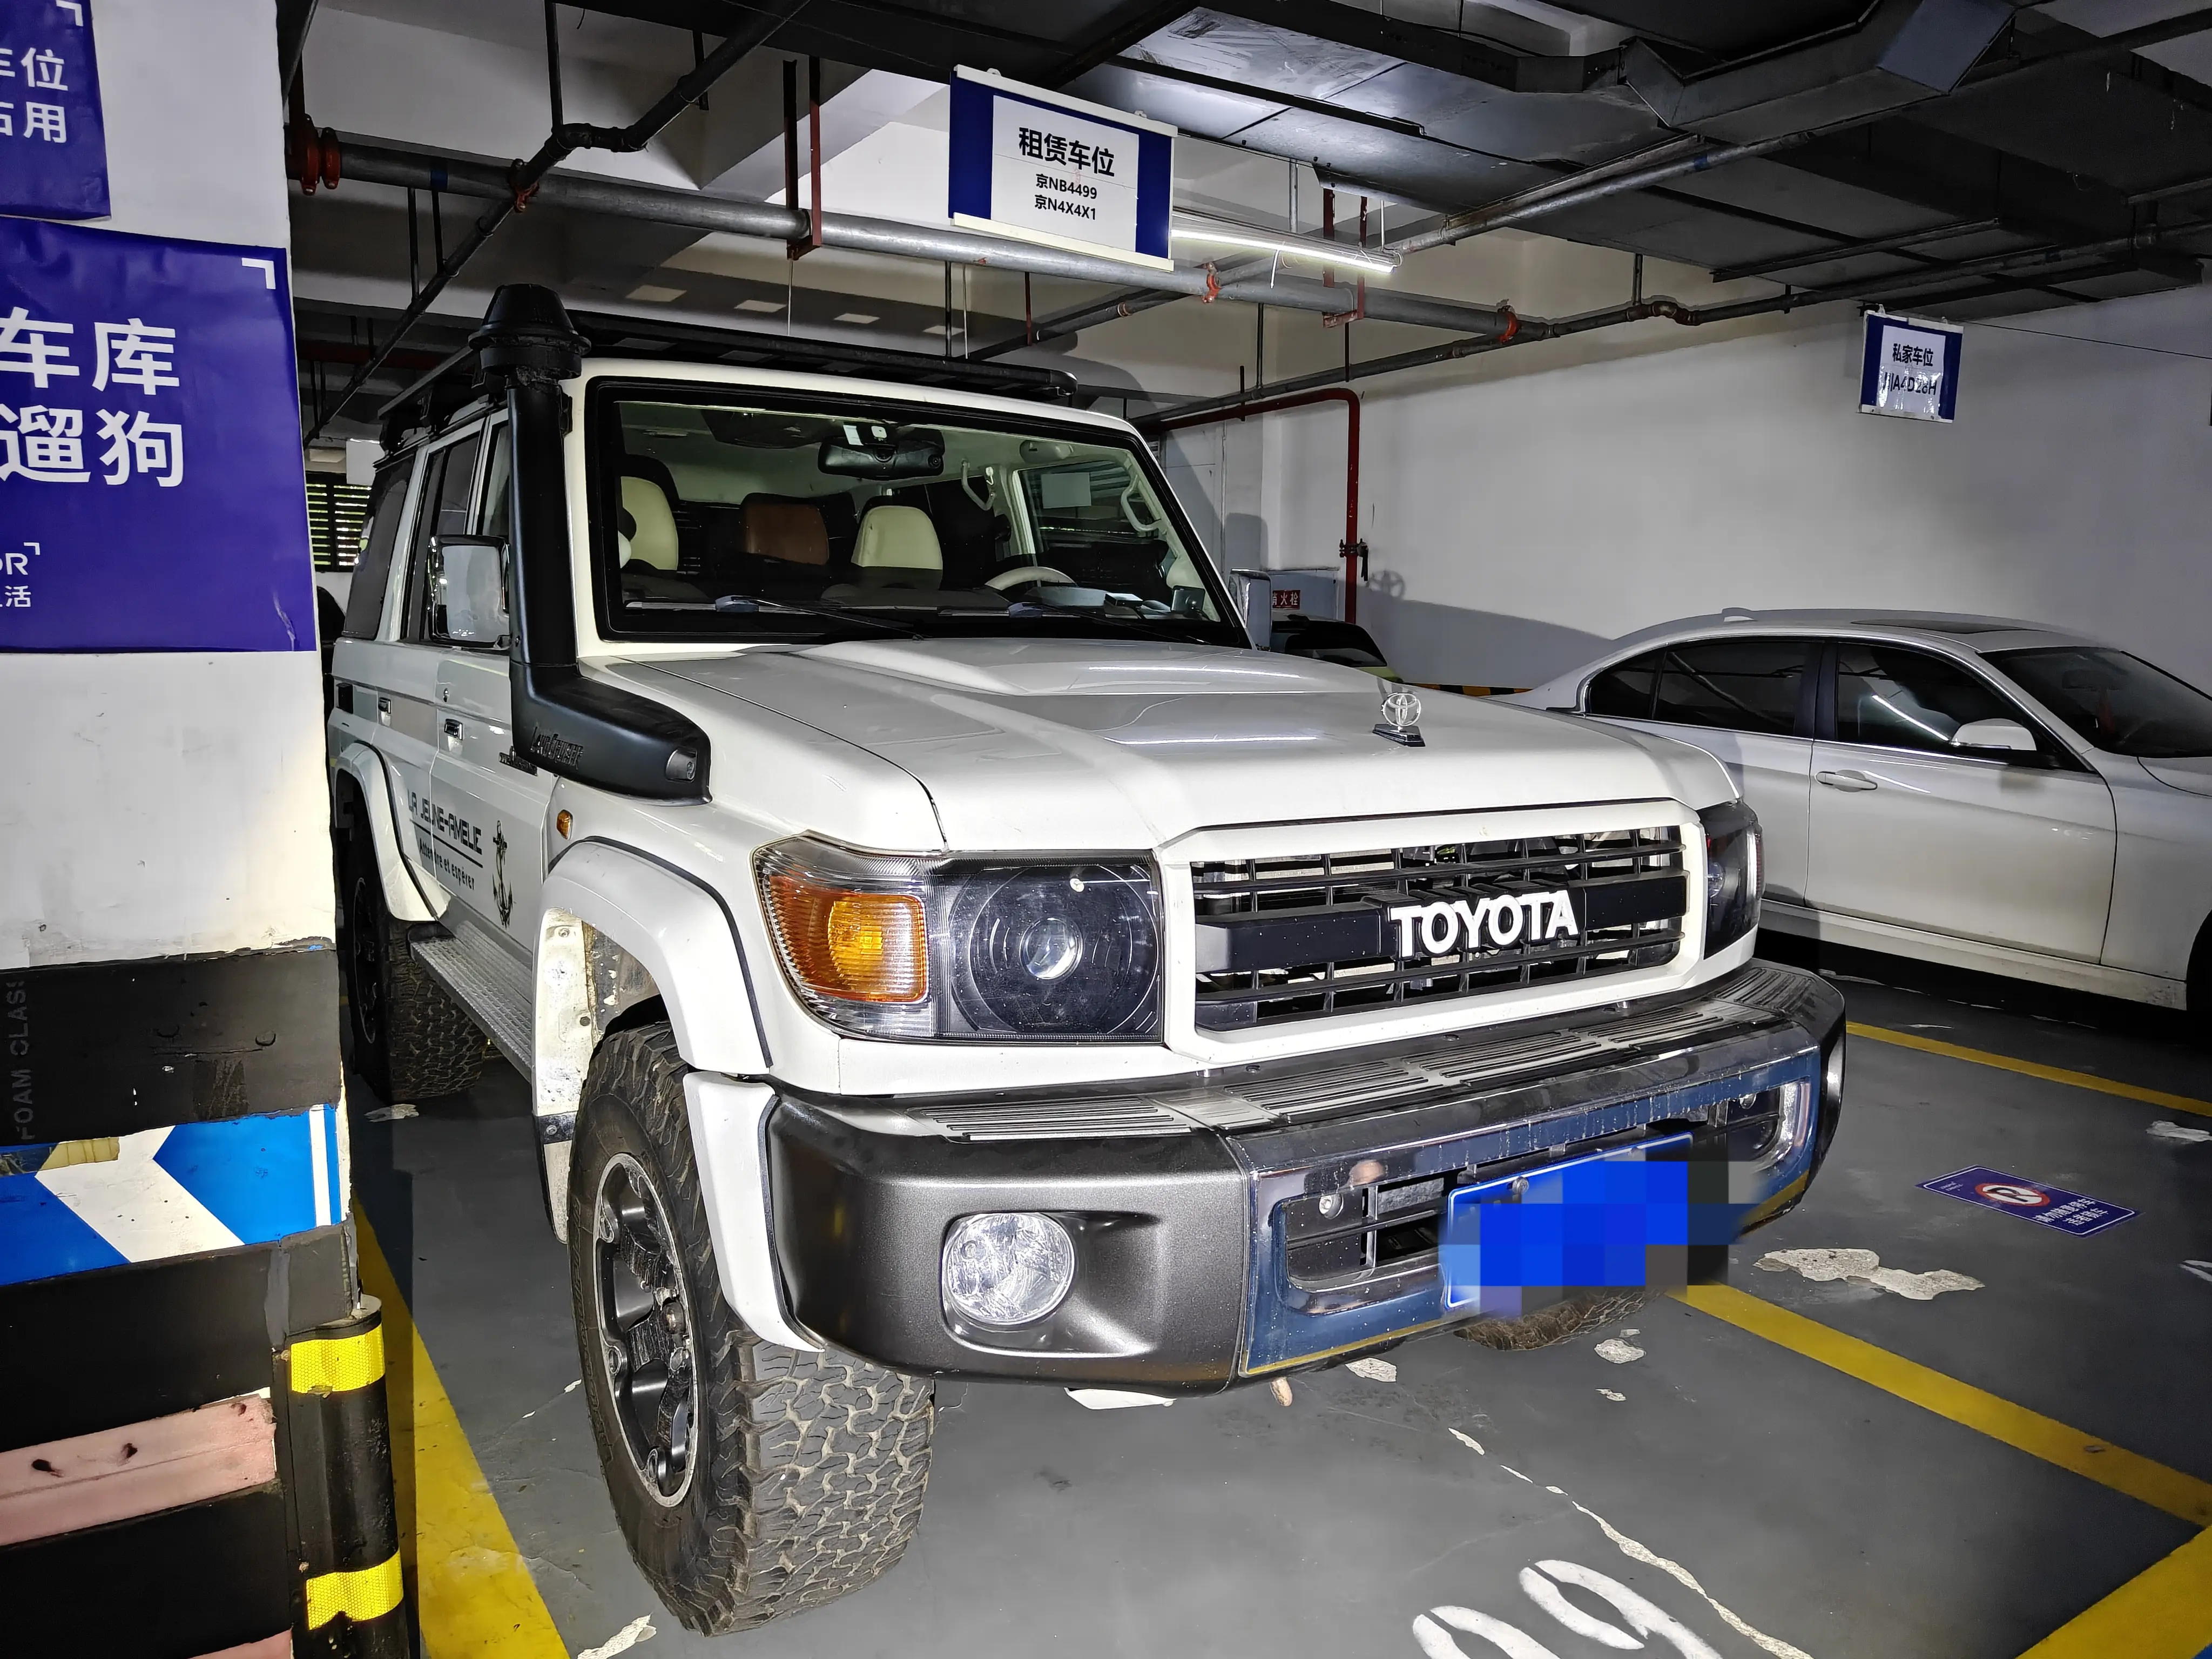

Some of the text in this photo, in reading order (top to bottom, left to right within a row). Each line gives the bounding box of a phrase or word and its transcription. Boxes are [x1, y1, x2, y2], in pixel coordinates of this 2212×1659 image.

[1019, 127, 1115, 177] 租赁车位
[1036, 173, 1097, 200] 京NB4499
[1034, 194, 1096, 220] 京N4X4X1
[0, 306, 180, 395] 车库
[1892, 343, 1934, 367] 私家车位
[0, 404, 184, 487] 遛狗
[0, 585, 32, 608] 活
[1389, 889, 1580, 958] TOYOTA
